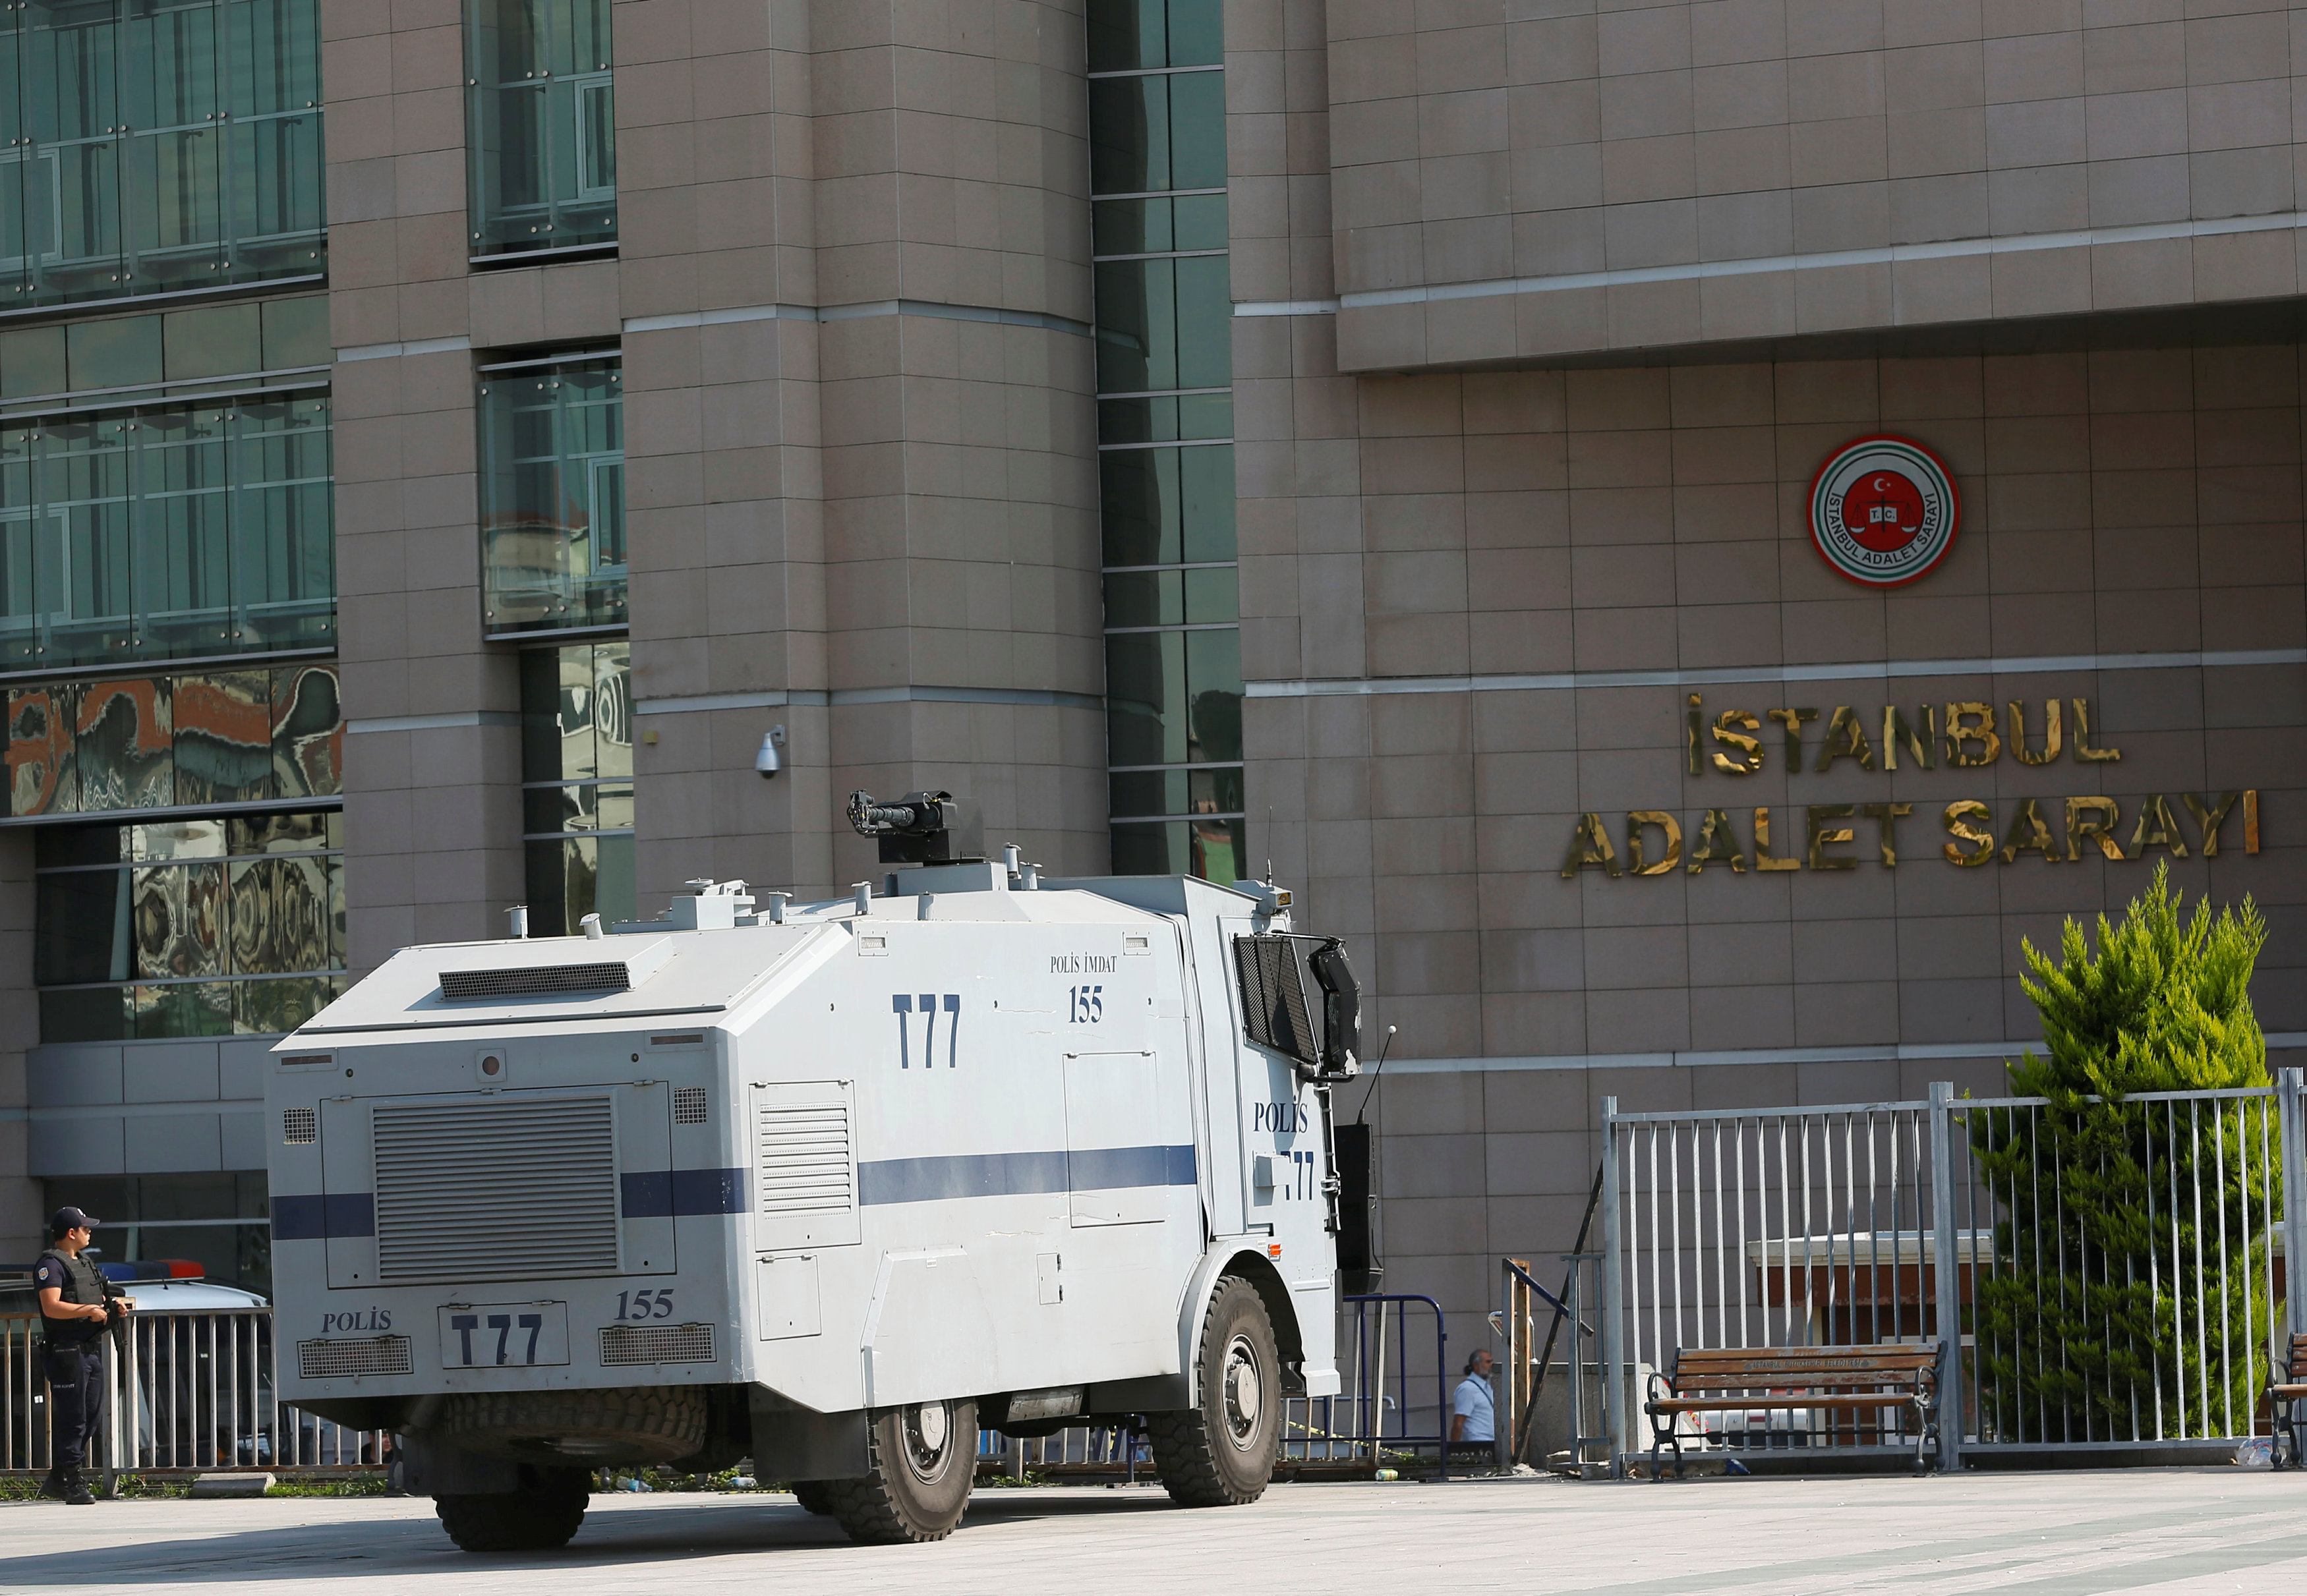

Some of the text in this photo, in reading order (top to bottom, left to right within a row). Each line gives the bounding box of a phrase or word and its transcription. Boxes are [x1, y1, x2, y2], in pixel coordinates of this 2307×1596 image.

[1862, 543, 1917, 565] ADALET
[1916, 492, 1938, 546] SARAYI
[1687, 692, 2120, 776] İSTANBUL
[1561, 789, 2260, 879] ADALET SARAYI
[1050, 951, 1118, 974] POLİS İMDAT
[1068, 985, 1103, 1023] 155
[892, 994, 960, 1069] T77
[1253, 1095, 1308, 1133] POLİS
[321, 1305, 392, 1334] POLİS
[614, 1288, 675, 1321] 155
[452, 1314, 542, 1365] T77
